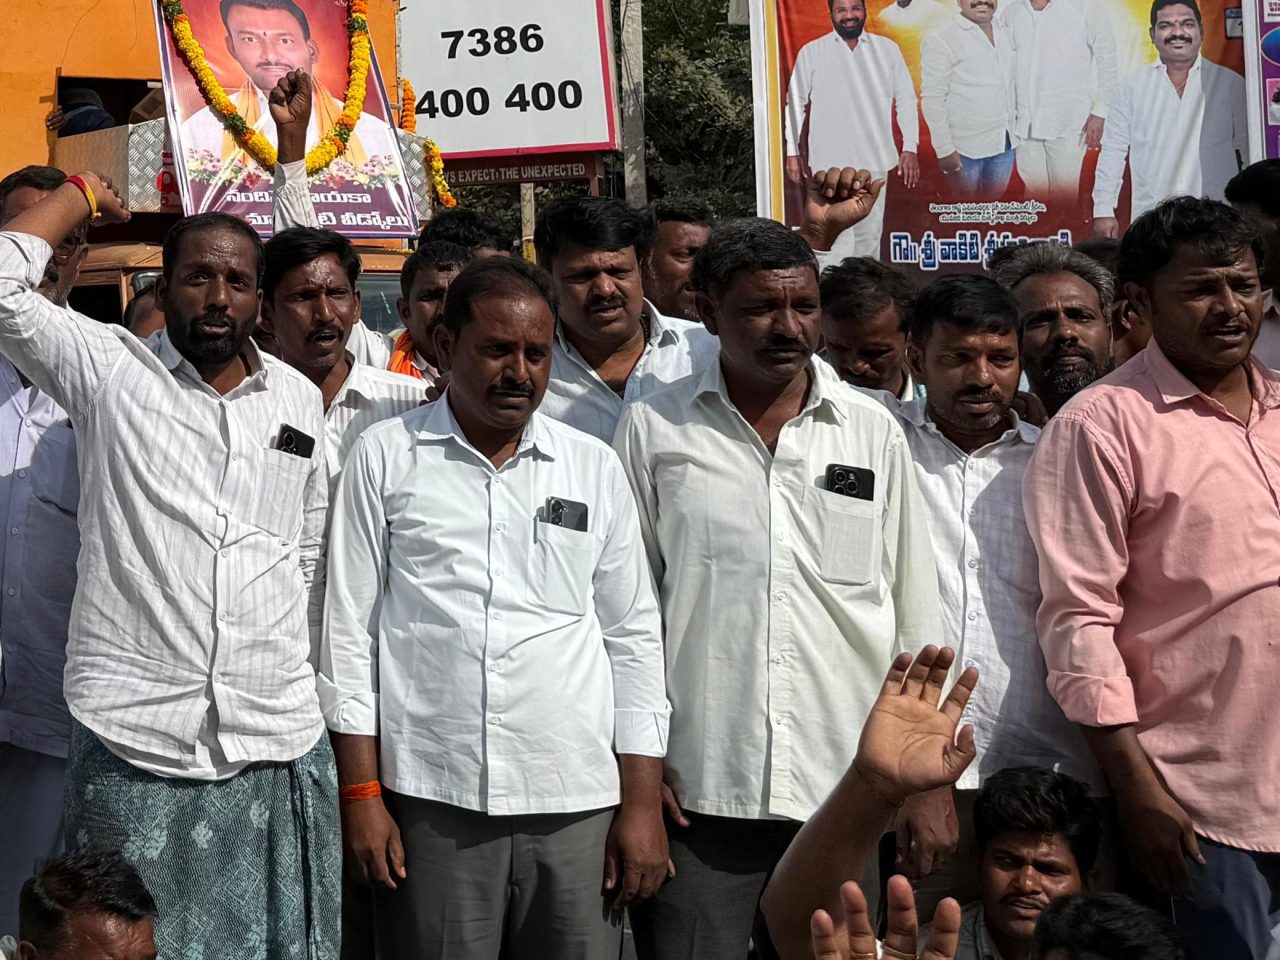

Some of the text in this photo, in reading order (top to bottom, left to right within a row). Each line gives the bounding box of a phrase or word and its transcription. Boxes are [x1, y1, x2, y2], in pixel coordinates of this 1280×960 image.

[441, 24, 544, 59] 7386
[415, 80, 583, 119] 400 400
[499, 167, 519, 180] THE
[521, 163, 585, 179] UNEXPECTED
